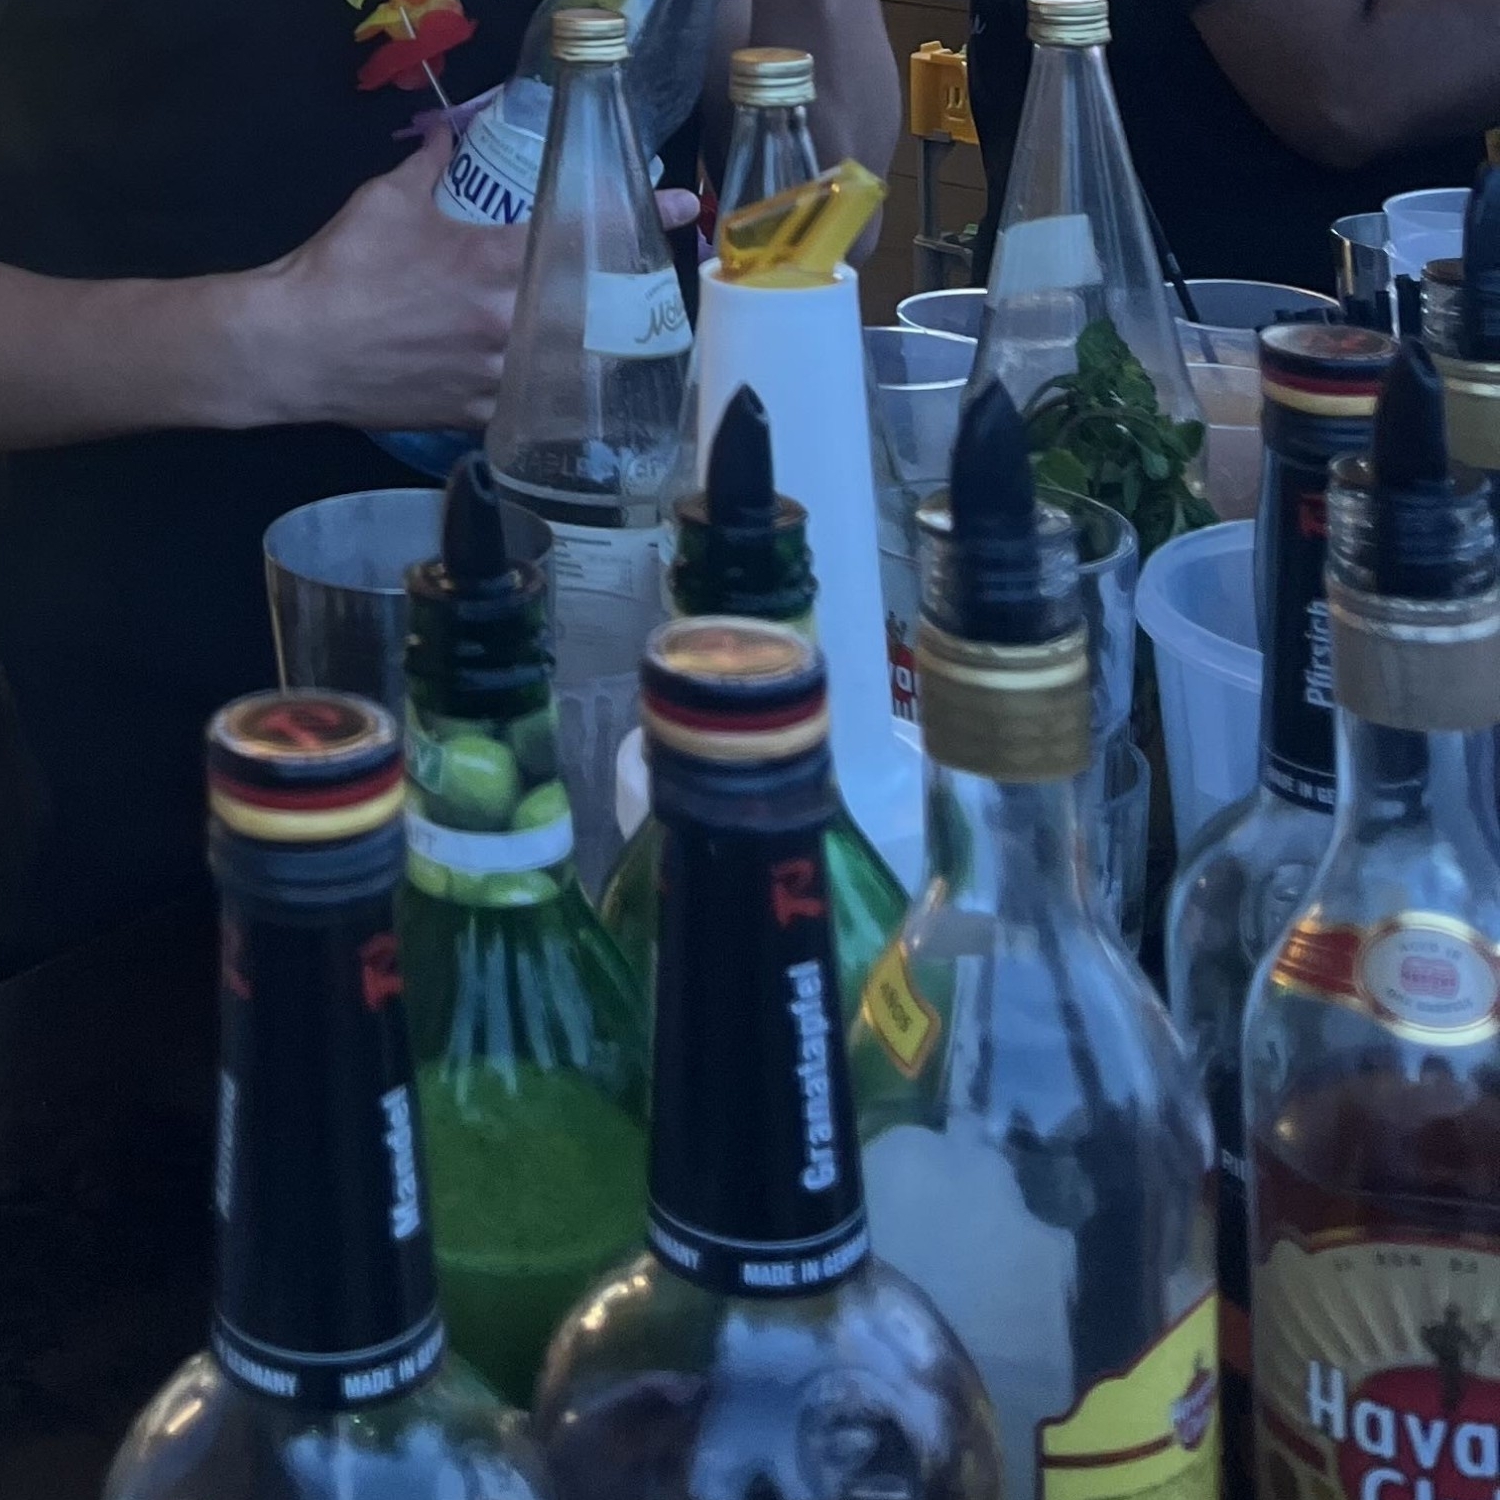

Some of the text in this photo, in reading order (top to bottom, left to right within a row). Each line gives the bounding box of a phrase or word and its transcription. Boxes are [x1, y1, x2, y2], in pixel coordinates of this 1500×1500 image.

[743, 1262, 795, 1286] MADE
[801, 1259, 819, 1283] IN
[344, 1367, 394, 1399] MADE
[399, 1355, 415, 1383] IN
